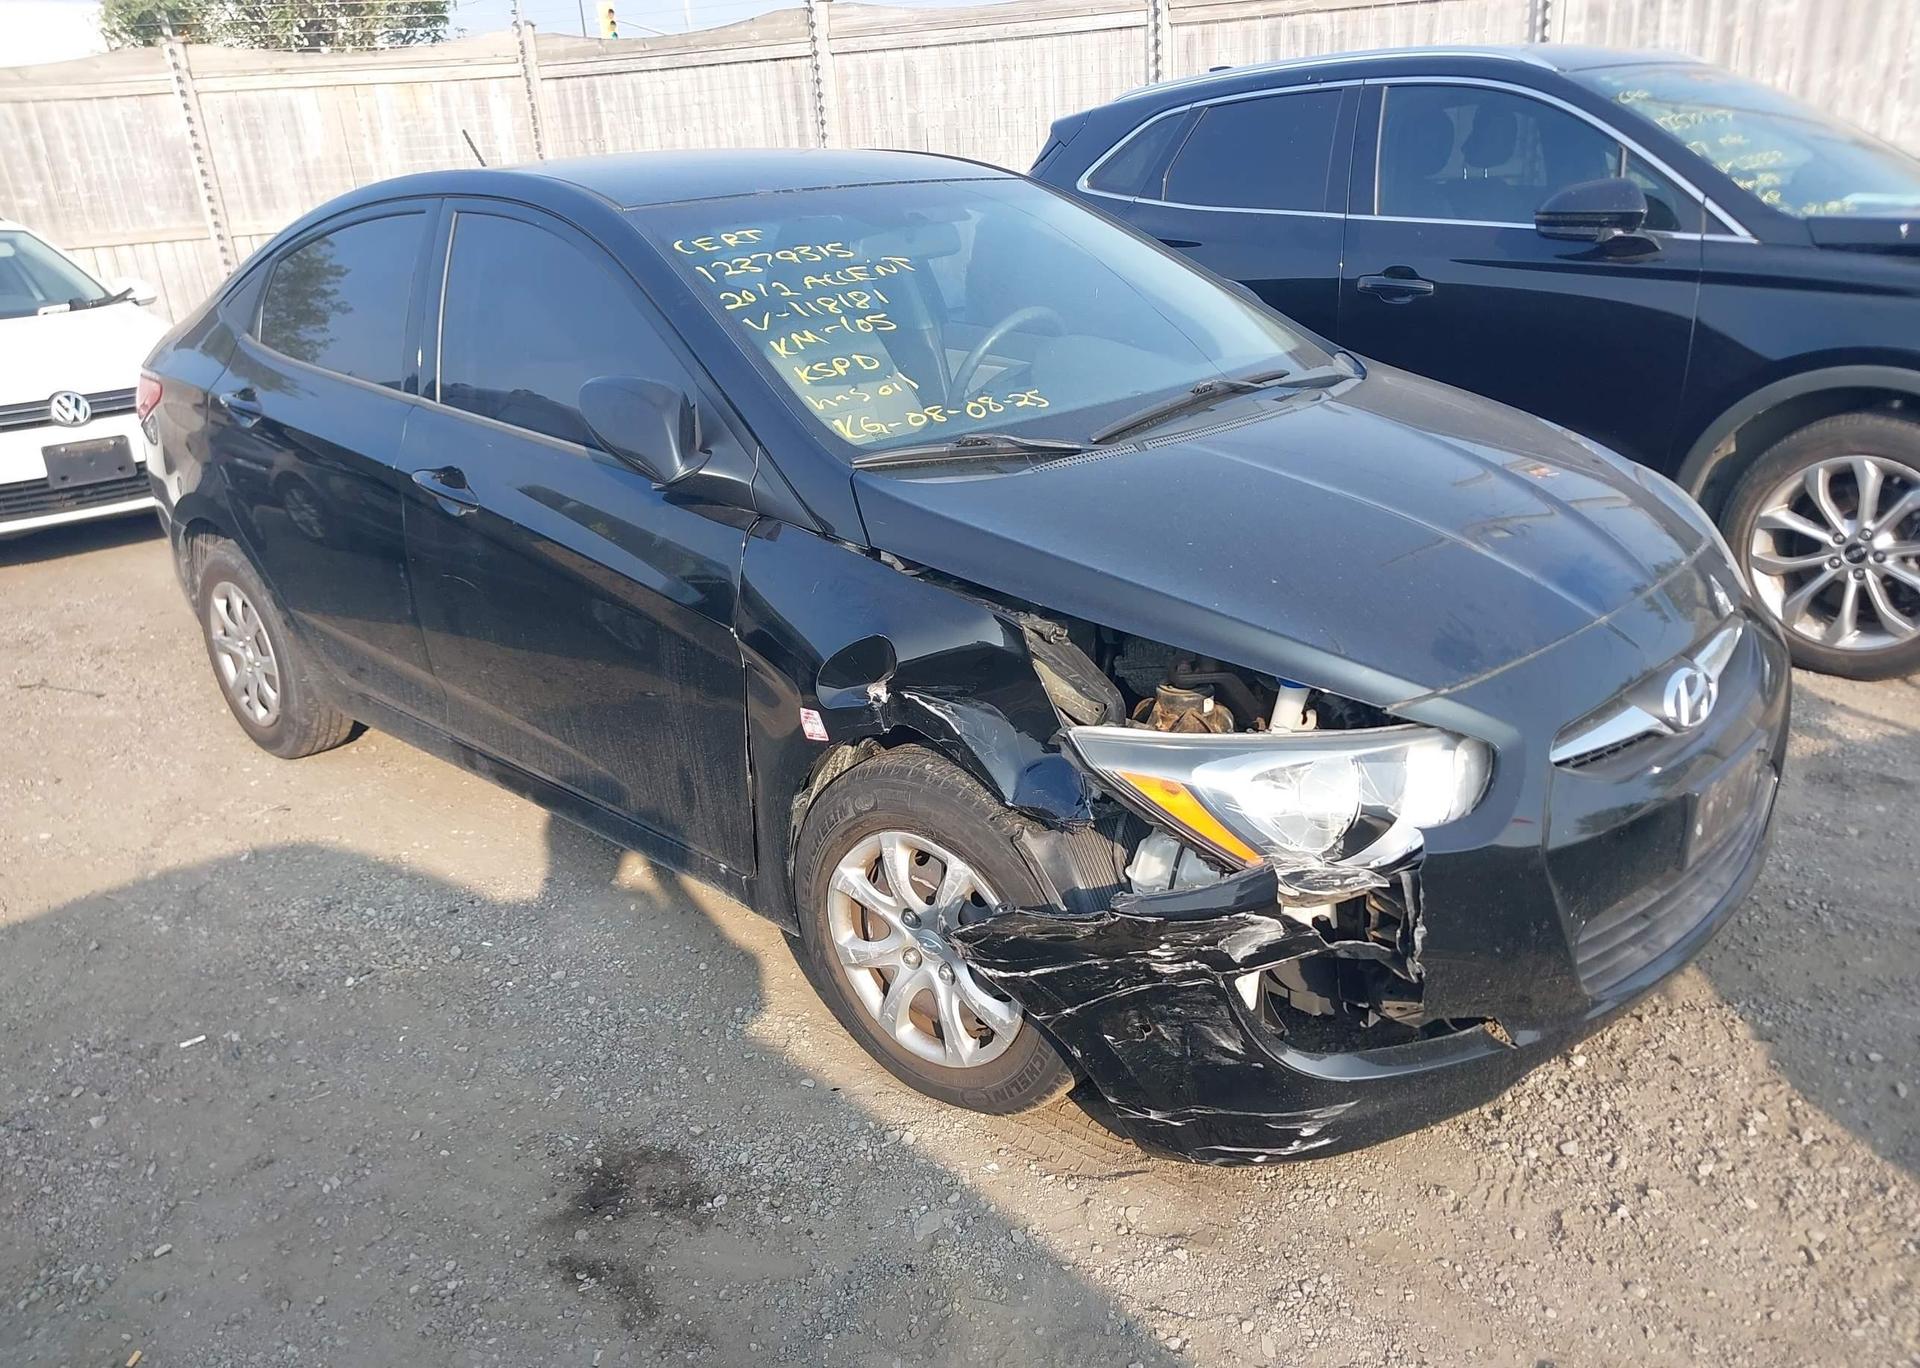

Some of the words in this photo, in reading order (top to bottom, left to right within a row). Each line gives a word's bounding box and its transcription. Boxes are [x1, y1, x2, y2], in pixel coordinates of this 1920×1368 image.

[673, 228, 763, 255] CERT
[695, 242, 854, 283] 12379315
[719, 281, 802, 310] 2012
[803, 256, 916, 289] ACCENT
[742, 289, 889, 331] V-118181
[793, 354, 880, 385] KSPD
